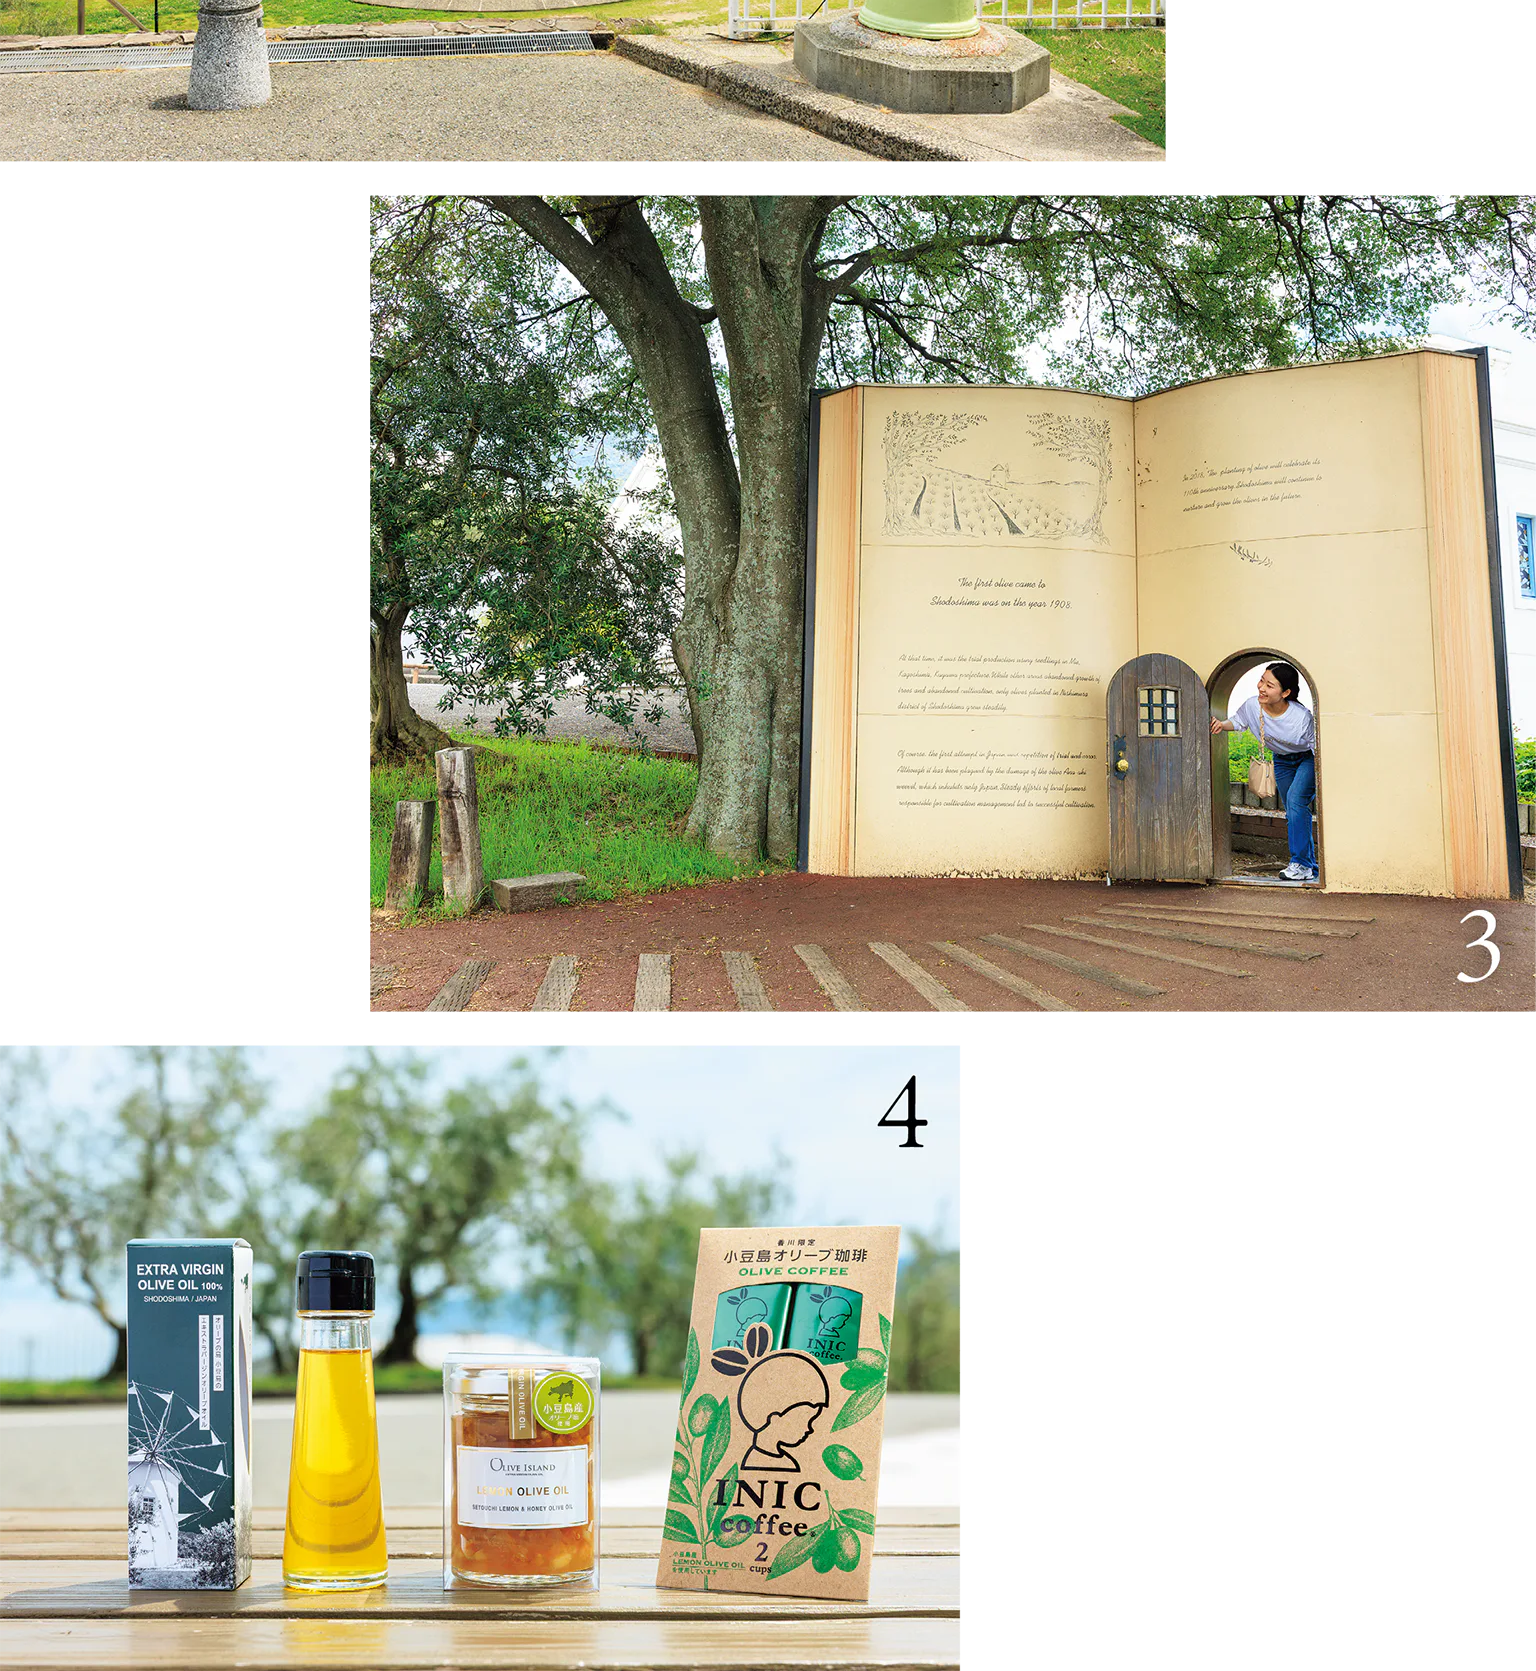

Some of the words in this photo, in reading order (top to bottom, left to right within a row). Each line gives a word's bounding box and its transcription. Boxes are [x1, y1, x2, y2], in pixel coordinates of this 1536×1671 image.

[1270, 461, 1282, 469] will
[1236, 480, 1272, 488] Shodoshima
[1204, 500, 1215, 509] and
[958, 577, 973, 587] The
[974, 577, 993, 590] first
[994, 578, 1013, 587] olive
[1038, 579, 1046, 589] to
[930, 595, 980, 606] Shodoshima
[1013, 597, 1026, 607] the
[1028, 600, 1047, 609] year
[1049, 600, 1072, 609] 1908.
[724, 1249, 868, 1263] 小豆島オリーブ珈琲
[137, 1264, 178, 1275] EXTRA
[181, 1264, 224, 1275] VIRGIN
[738, 1267, 783, 1276] OLIVE
[787, 1267, 848, 1276] COFFEE
[138, 1280, 174, 1290] OLIVE
[178, 1280, 198, 1290] OIL
[201, 1282, 223, 1290] 100%
[807, 1338, 846, 1352] INIC
[490, 1457, 520, 1472] OLIVE
[524, 1462, 556, 1471] ISLAND
[477, 1486, 512, 1496] LEMON
[517, 1487, 550, 1496] OLIVE
[554, 1486, 569, 1495] OIL
[713, 1479, 821, 1511] INIC
[755, 1542, 768, 1562] 2
[750, 1565, 772, 1574] cups
